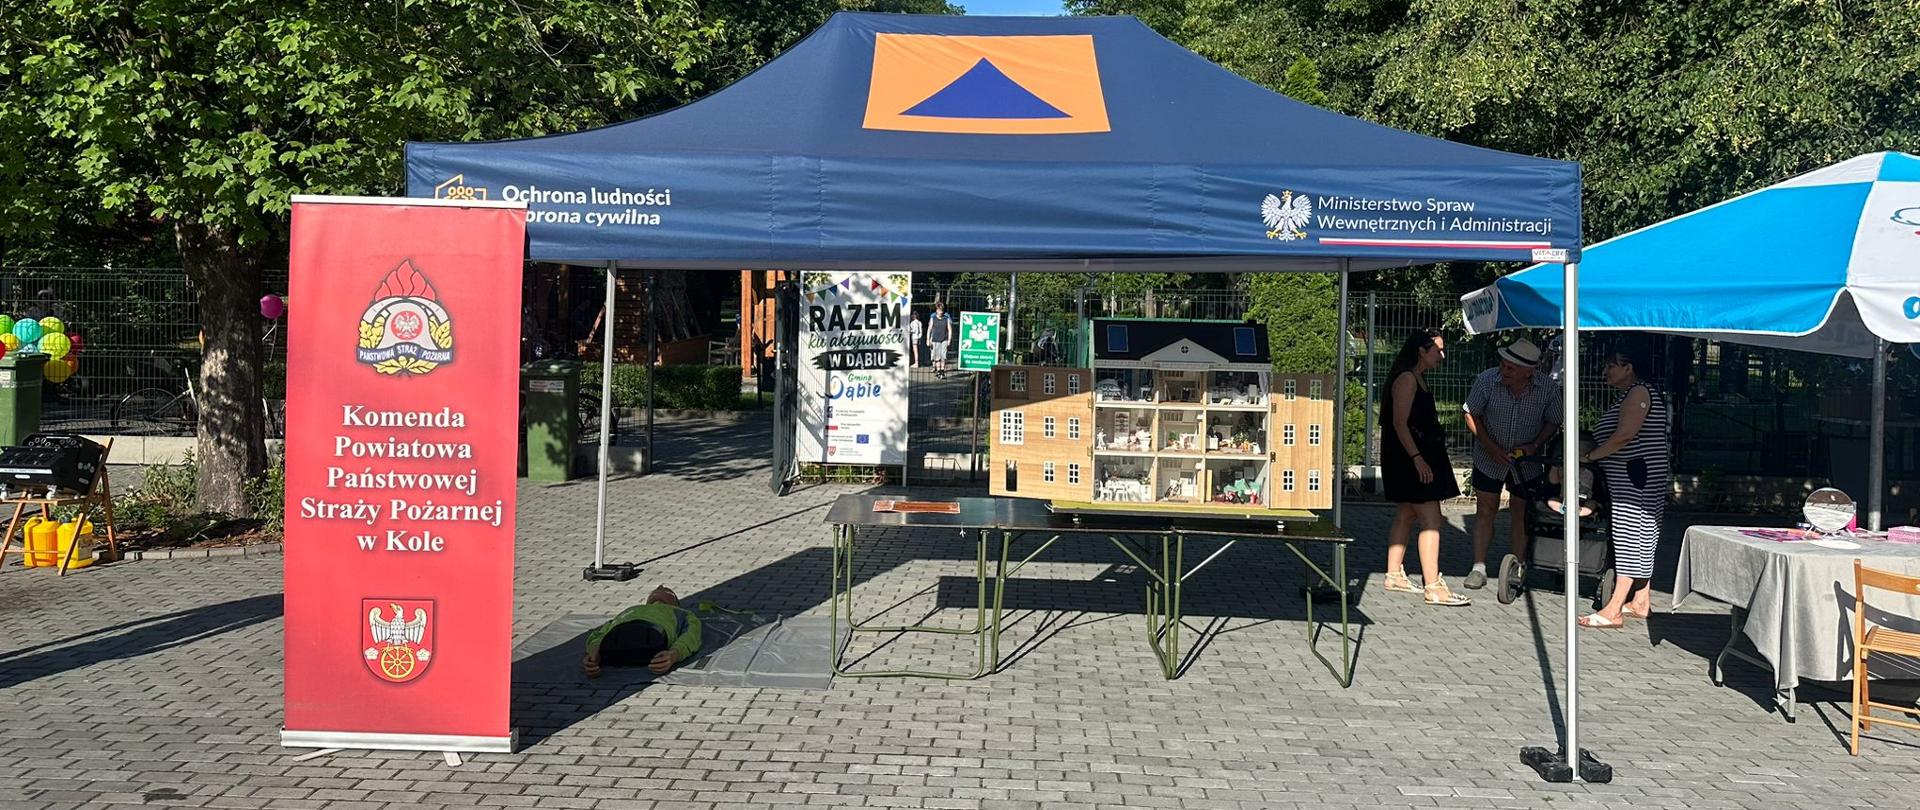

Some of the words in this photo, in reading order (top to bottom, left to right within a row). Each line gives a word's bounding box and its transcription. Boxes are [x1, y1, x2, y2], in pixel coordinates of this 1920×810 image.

[502, 185, 587, 205] Ochrona
[591, 186, 671, 206] ludności
[1317, 195, 1423, 212] Ministerstwo
[1426, 198, 1475, 214] Spraw
[585, 209, 661, 226] cywilna
[1316, 214, 1436, 233] Wewnętrznych
[1440, 217, 1445, 231] i
[1449, 217, 1552, 236] Administracji
[808, 303, 901, 332] RAZEM
[808, 333, 826, 349] ku
[829, 329, 905, 351] aktywności
[828, 353, 841, 368] W
[846, 352, 887, 369] DĄBIU
[342, 405, 465, 428] Komenda
[334, 436, 472, 459] Powiatowa
[326, 467, 477, 496] Państwowej
[300, 497, 381, 525] Straży
[389, 499, 502, 526] Pożarnej
[357, 535, 377, 551] w
[386, 530, 445, 552] Kole
